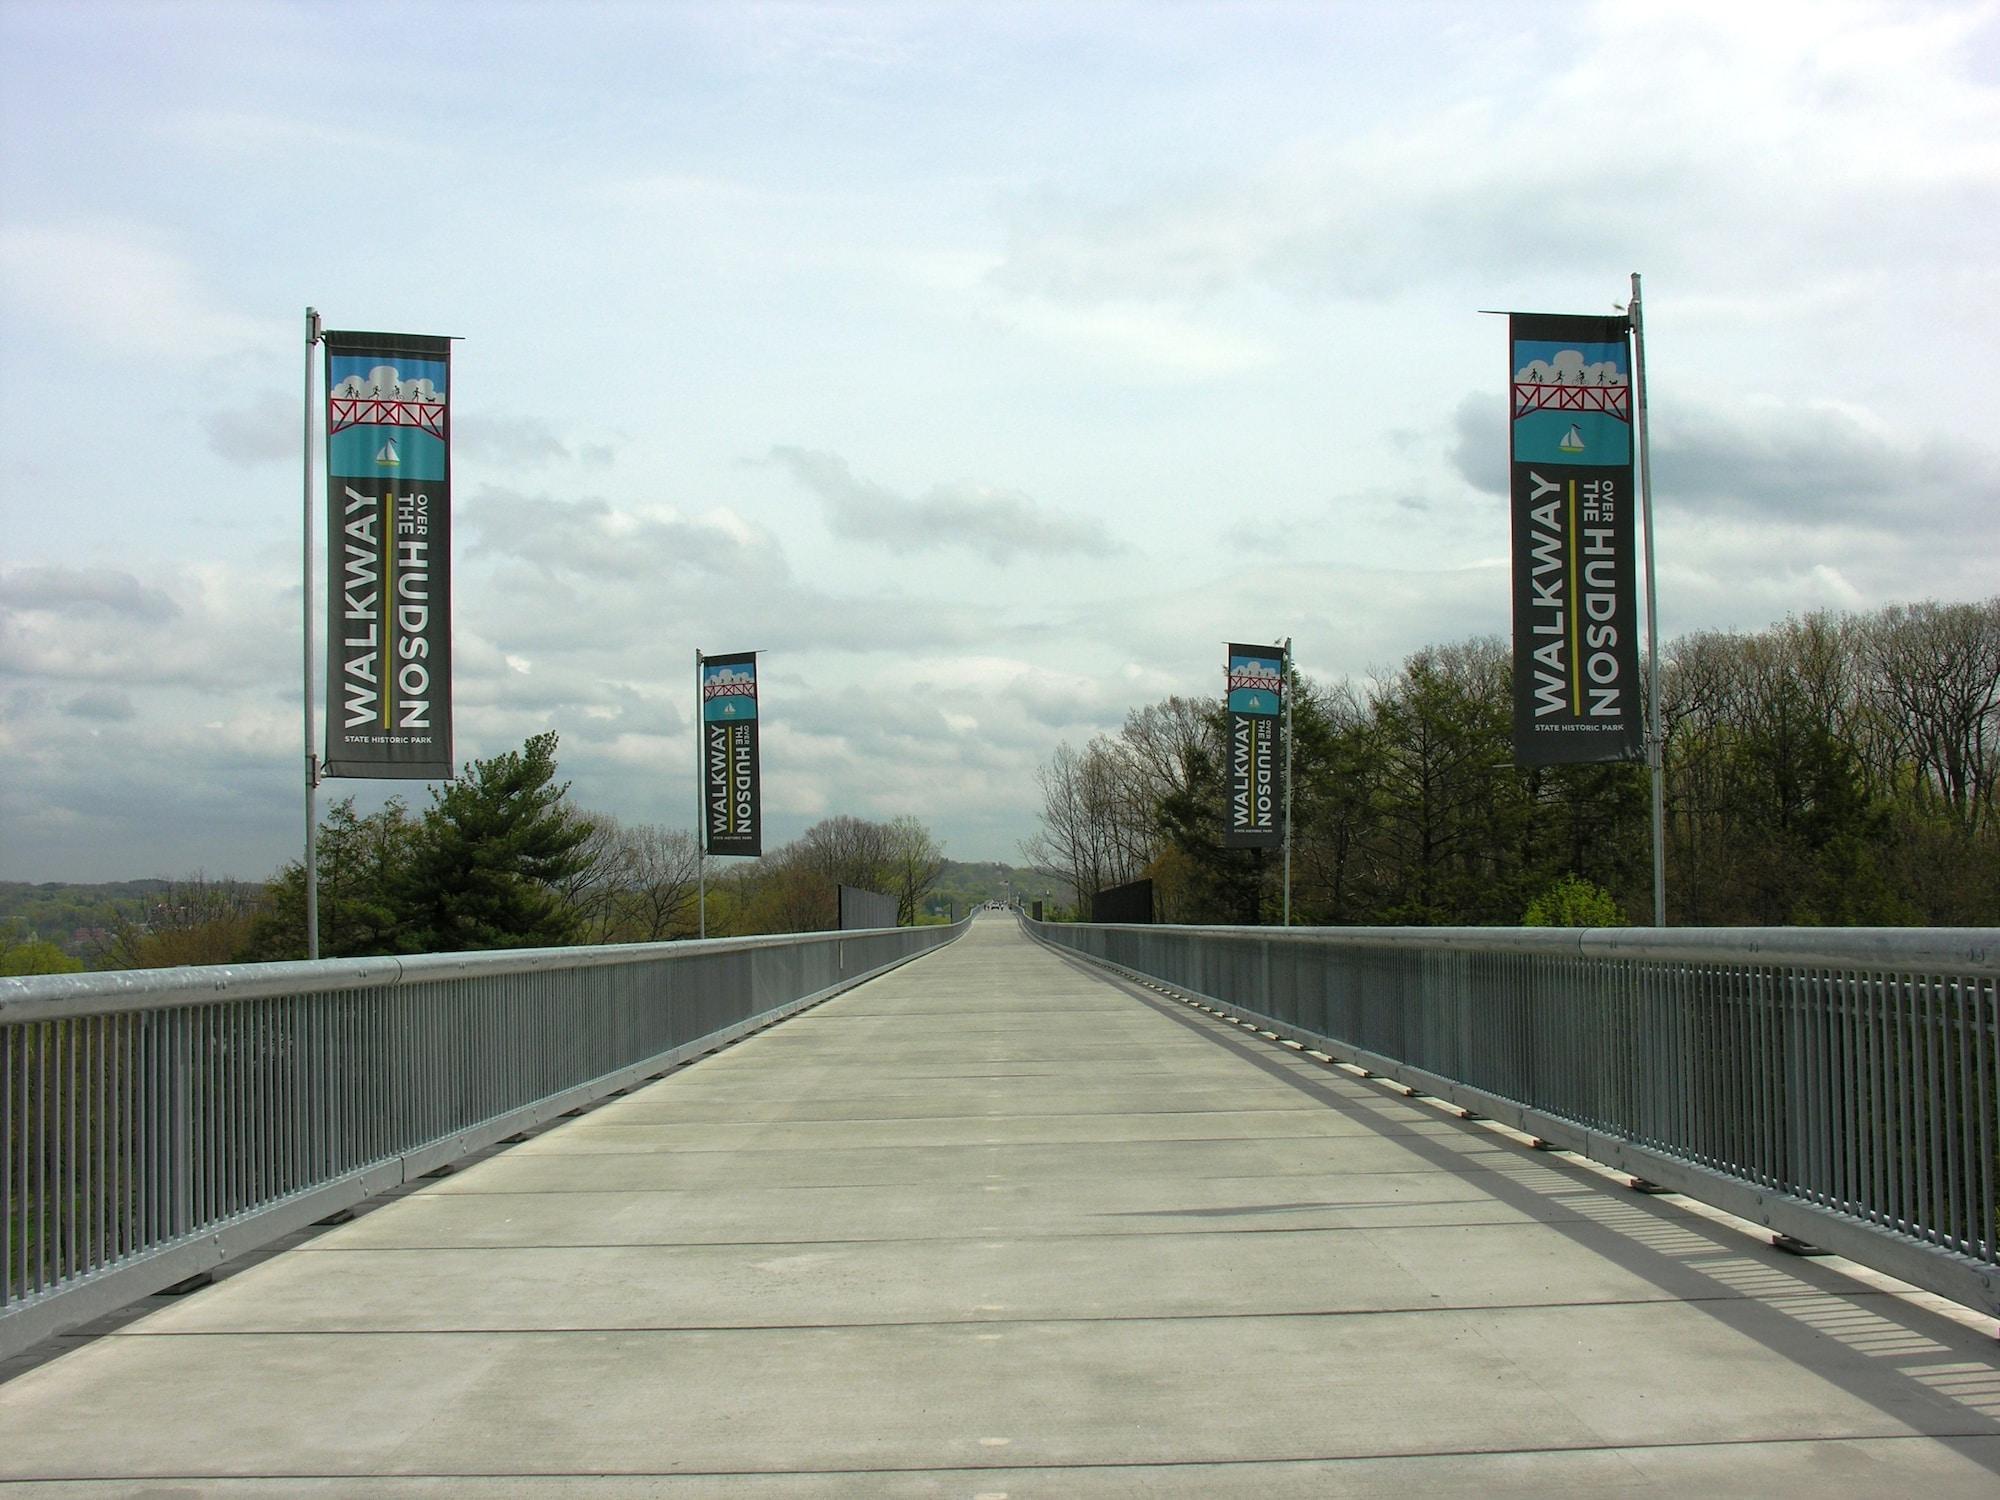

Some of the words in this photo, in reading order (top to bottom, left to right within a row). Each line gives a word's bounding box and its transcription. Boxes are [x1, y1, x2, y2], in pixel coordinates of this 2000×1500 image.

[399, 493, 414, 534] THE
[417, 494, 428, 535] OVER
[1583, 480, 1599, 522] THE
[1602, 480, 1613, 522] OVER
[345, 485, 377, 728] WALKWAY
[398, 542, 430, 728] HUDSON
[1530, 471, 1567, 717] WALKWAY
[1584, 528, 1621, 716] HUDSON
[735, 727, 743, 745] THE
[1234, 716, 1249, 826] WALKWAY
[711, 725, 727, 834] WALKWAY
[736, 747, 751, 833] HUDSON
[1258, 741, 1271, 826] HUDSON
